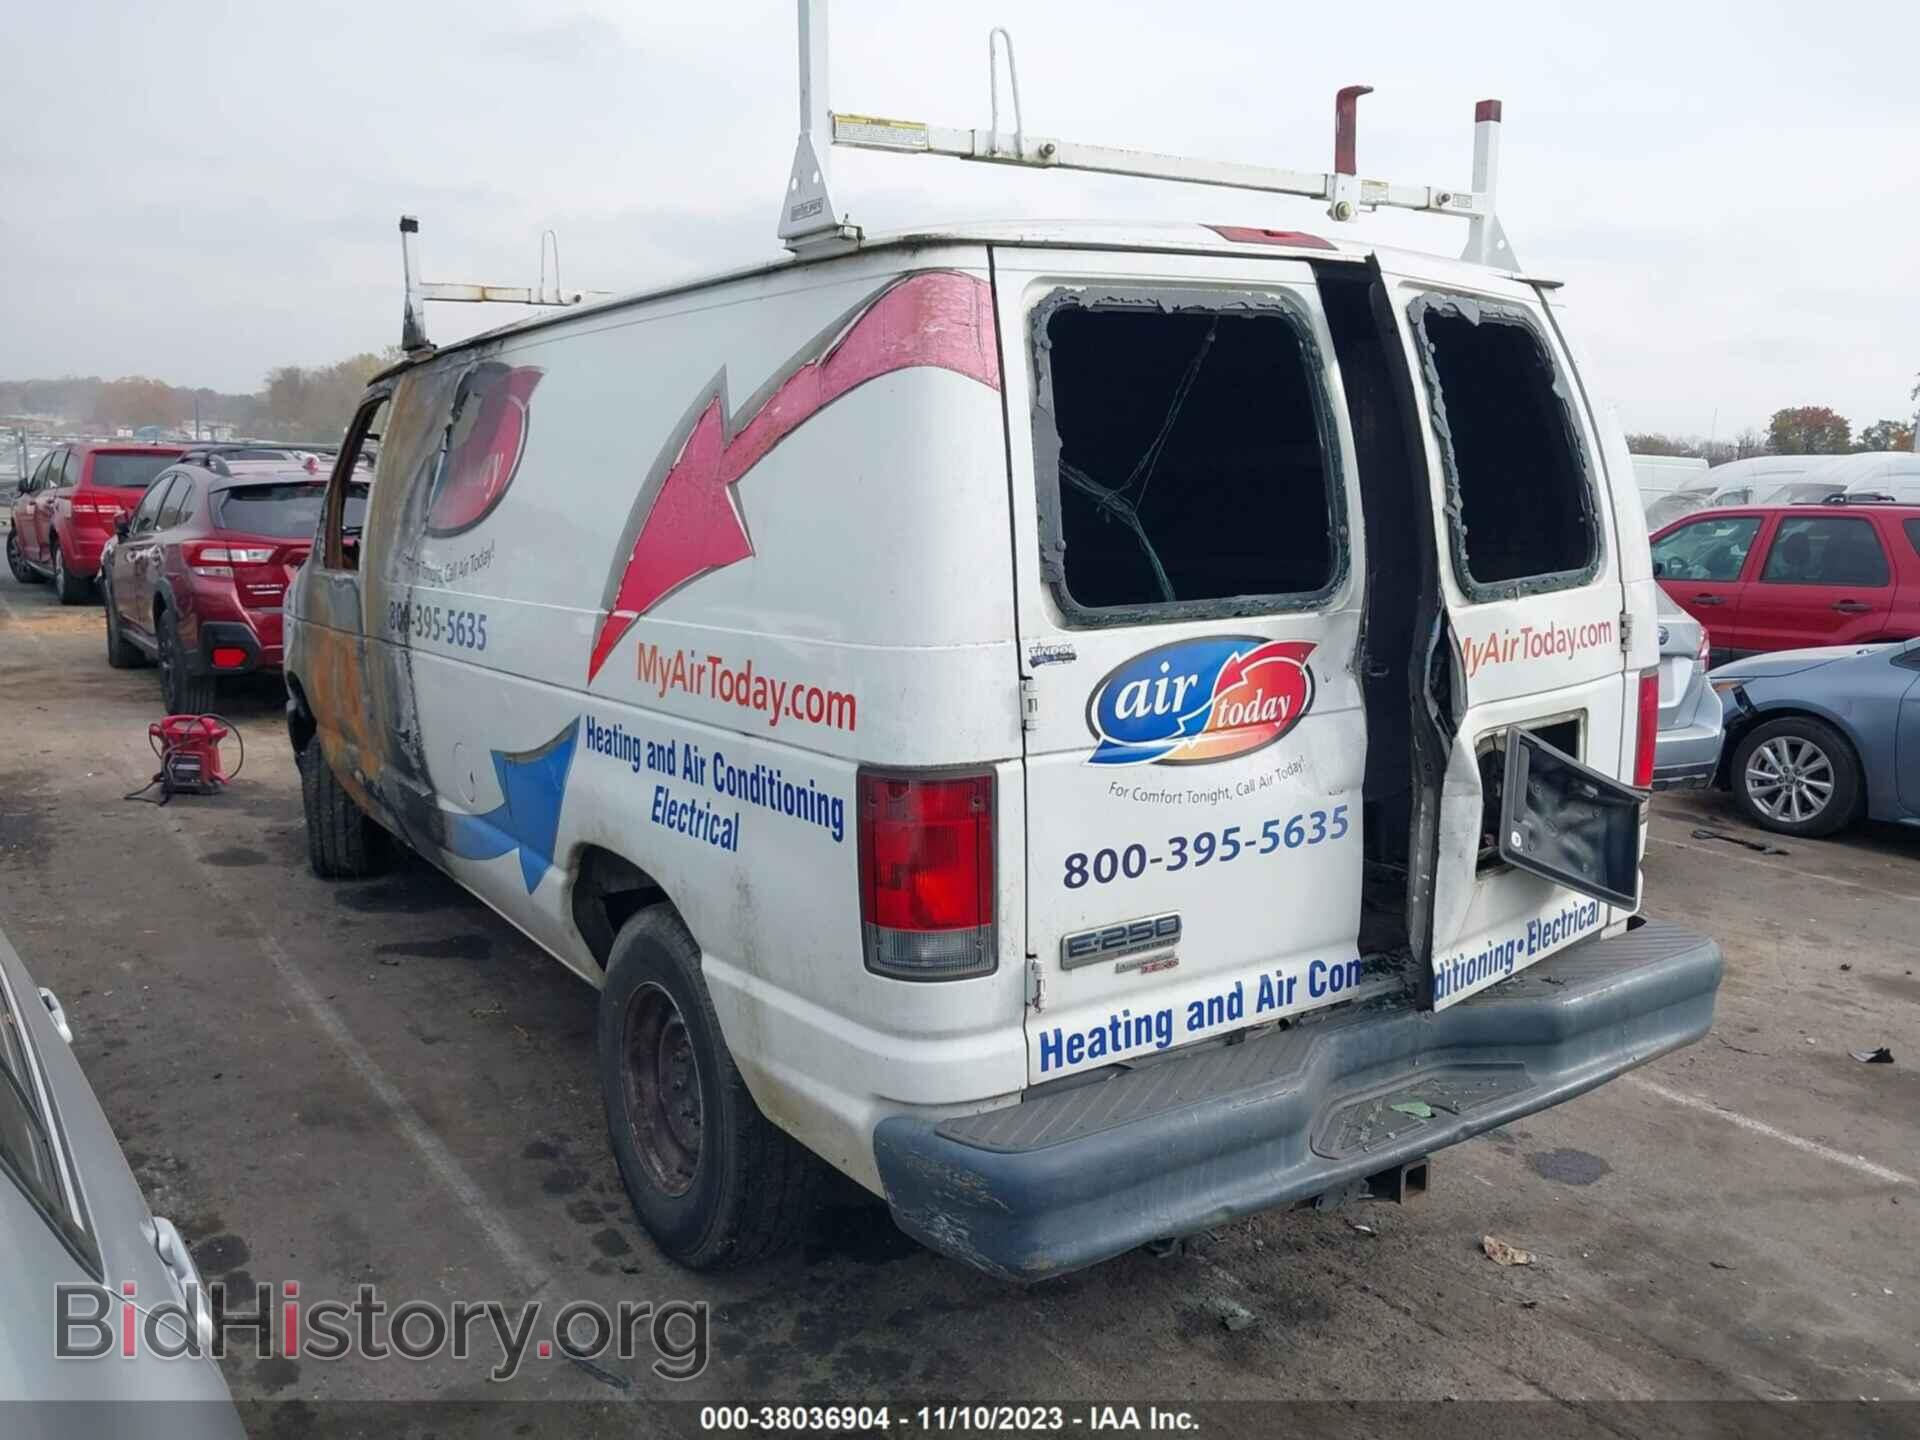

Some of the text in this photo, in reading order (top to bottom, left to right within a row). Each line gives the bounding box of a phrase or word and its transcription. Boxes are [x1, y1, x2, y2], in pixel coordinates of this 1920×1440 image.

[637, 642, 857, 731] MyAirToday.com
[1115, 661, 1198, 720] air
[1217, 688, 1290, 728] today
[586, 715, 844, 843] Heating and Air Conditioning
[1109, 755, 1306, 806] For Comfort Tonight, Call Air Today!
[651, 785, 740, 852] Electrical
[1063, 804, 1349, 889] 800-395-5635
[1066, 914, 1181, 958] E-250
[1039, 959, 1361, 1073] Heating and Air Con
